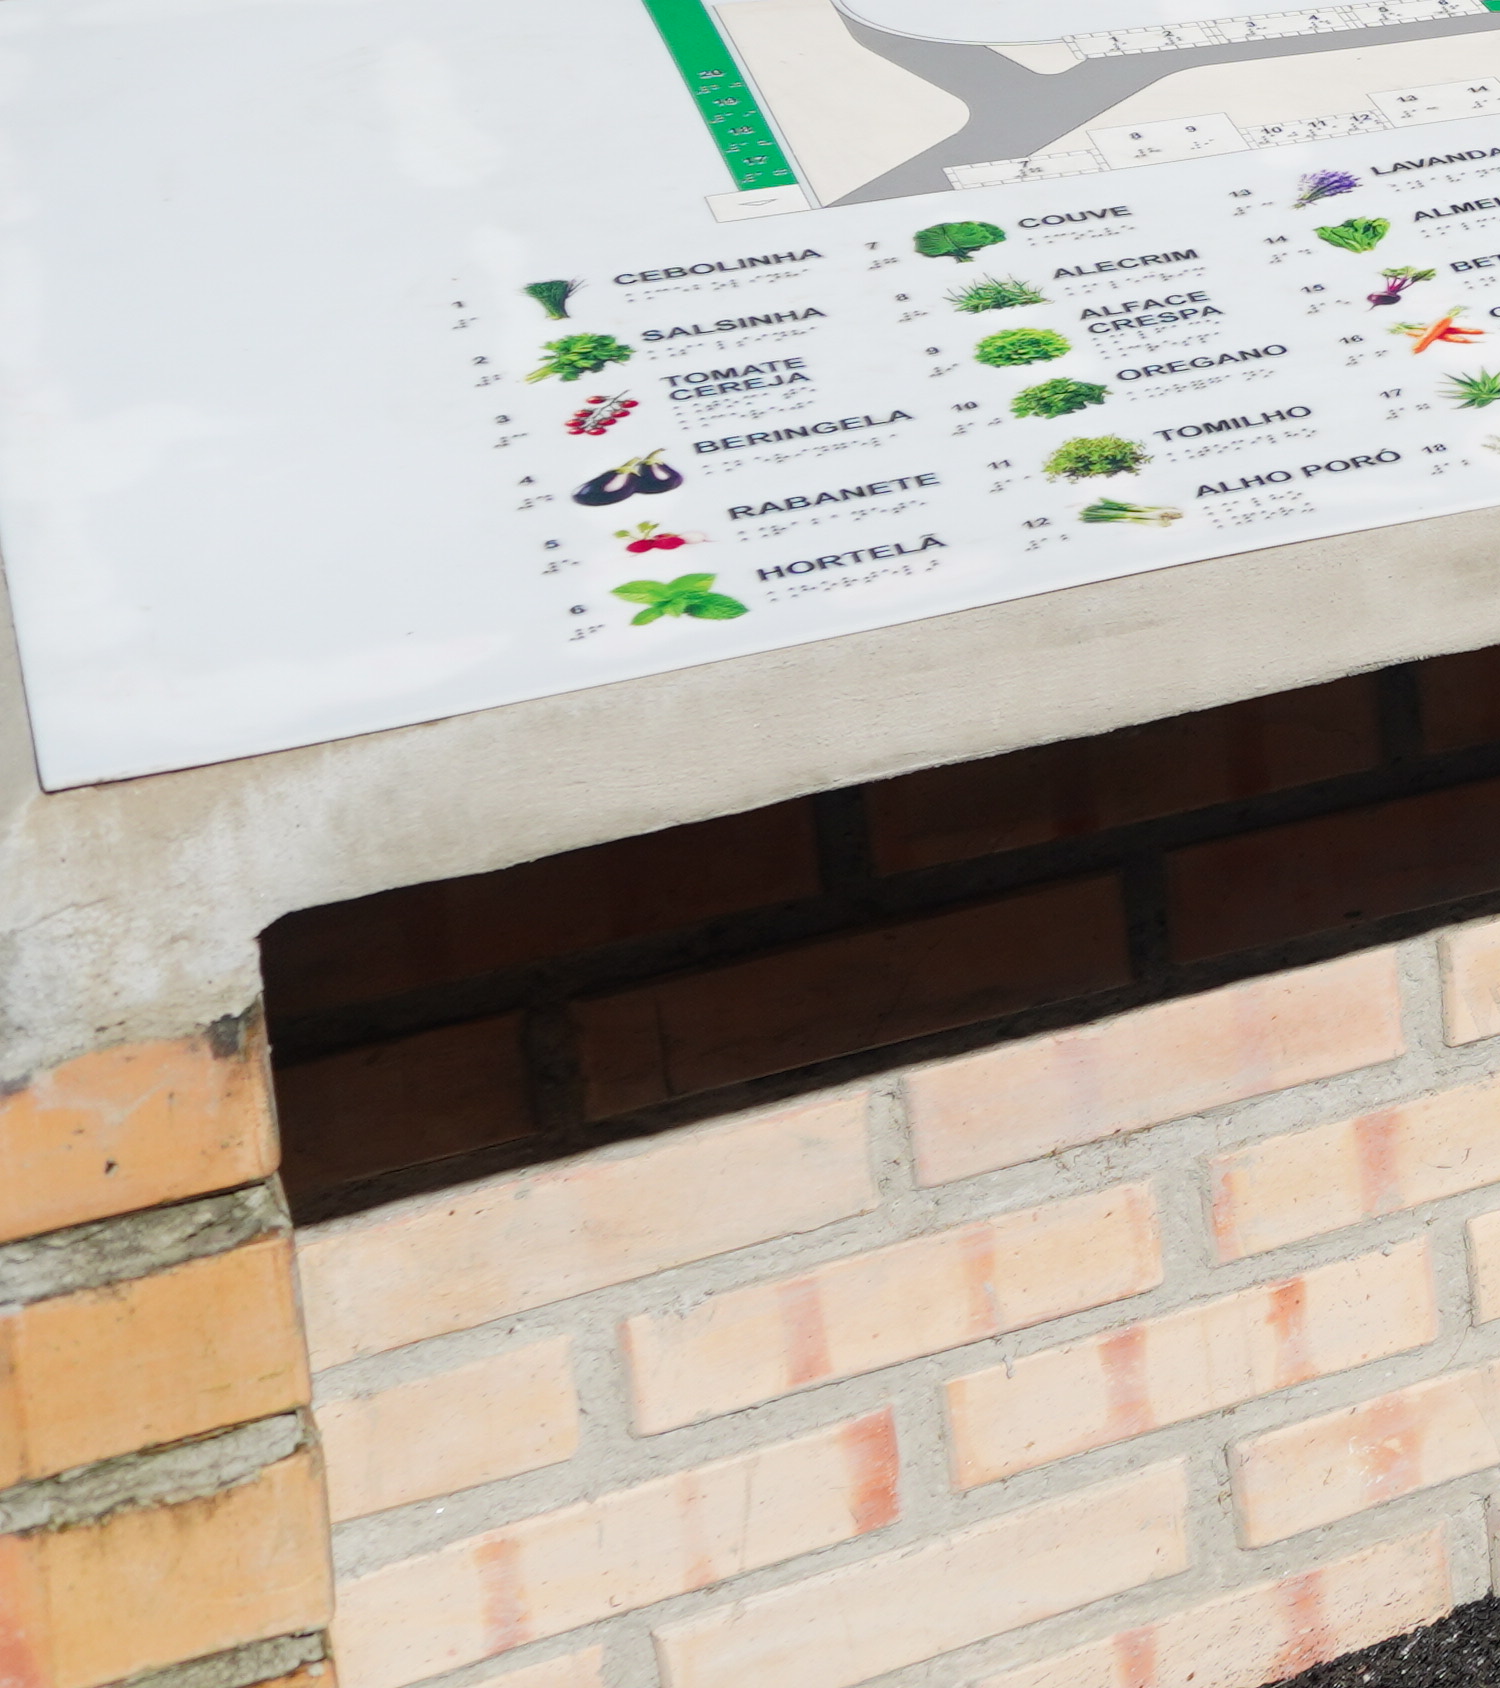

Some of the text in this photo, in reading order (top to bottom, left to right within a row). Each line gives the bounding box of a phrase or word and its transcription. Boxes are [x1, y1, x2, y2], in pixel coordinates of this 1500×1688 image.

[1229, 188, 1252, 198] 13
[1017, 204, 1134, 229] COUVE
[1264, 235, 1289, 244] 14
[864, 241, 879, 250] 7
[612, 248, 824, 285] CEBOLINHA
[1052, 247, 1200, 280] ALECRIM
[1300, 283, 1325, 293] 15
[896, 293, 910, 302] 8
[1079, 290, 1211, 321] ALFACE
[641, 307, 828, 342] SALSINHA
[1087, 305, 1225, 335] CRESPA
[1339, 334, 1363, 345] 16
[926, 346, 940, 356] 9
[472, 356, 488, 365] 2
[1116, 344, 1289, 382] OREGANO
[660, 357, 806, 386] TOMATE
[669, 372, 812, 402] CEREJA
[1379, 388, 1403, 399] 17
[951, 401, 978, 412] 10
[495, 414, 511, 424] 3
[1153, 405, 1312, 443] TOMILHO
[692, 409, 915, 455] BERINGELA
[1422, 443, 1447, 454] 18
[987, 459, 1012, 470] 11
[1196, 448, 1402, 499] ALHO PORÓ
[518, 475, 535, 485] 4
[726, 472, 941, 521] RABANETE
[1021, 516, 1051, 528] 12
[544, 539, 561, 549] 5
[757, 533, 949, 583] HORTELÃ
[570, 605, 588, 615] 6
